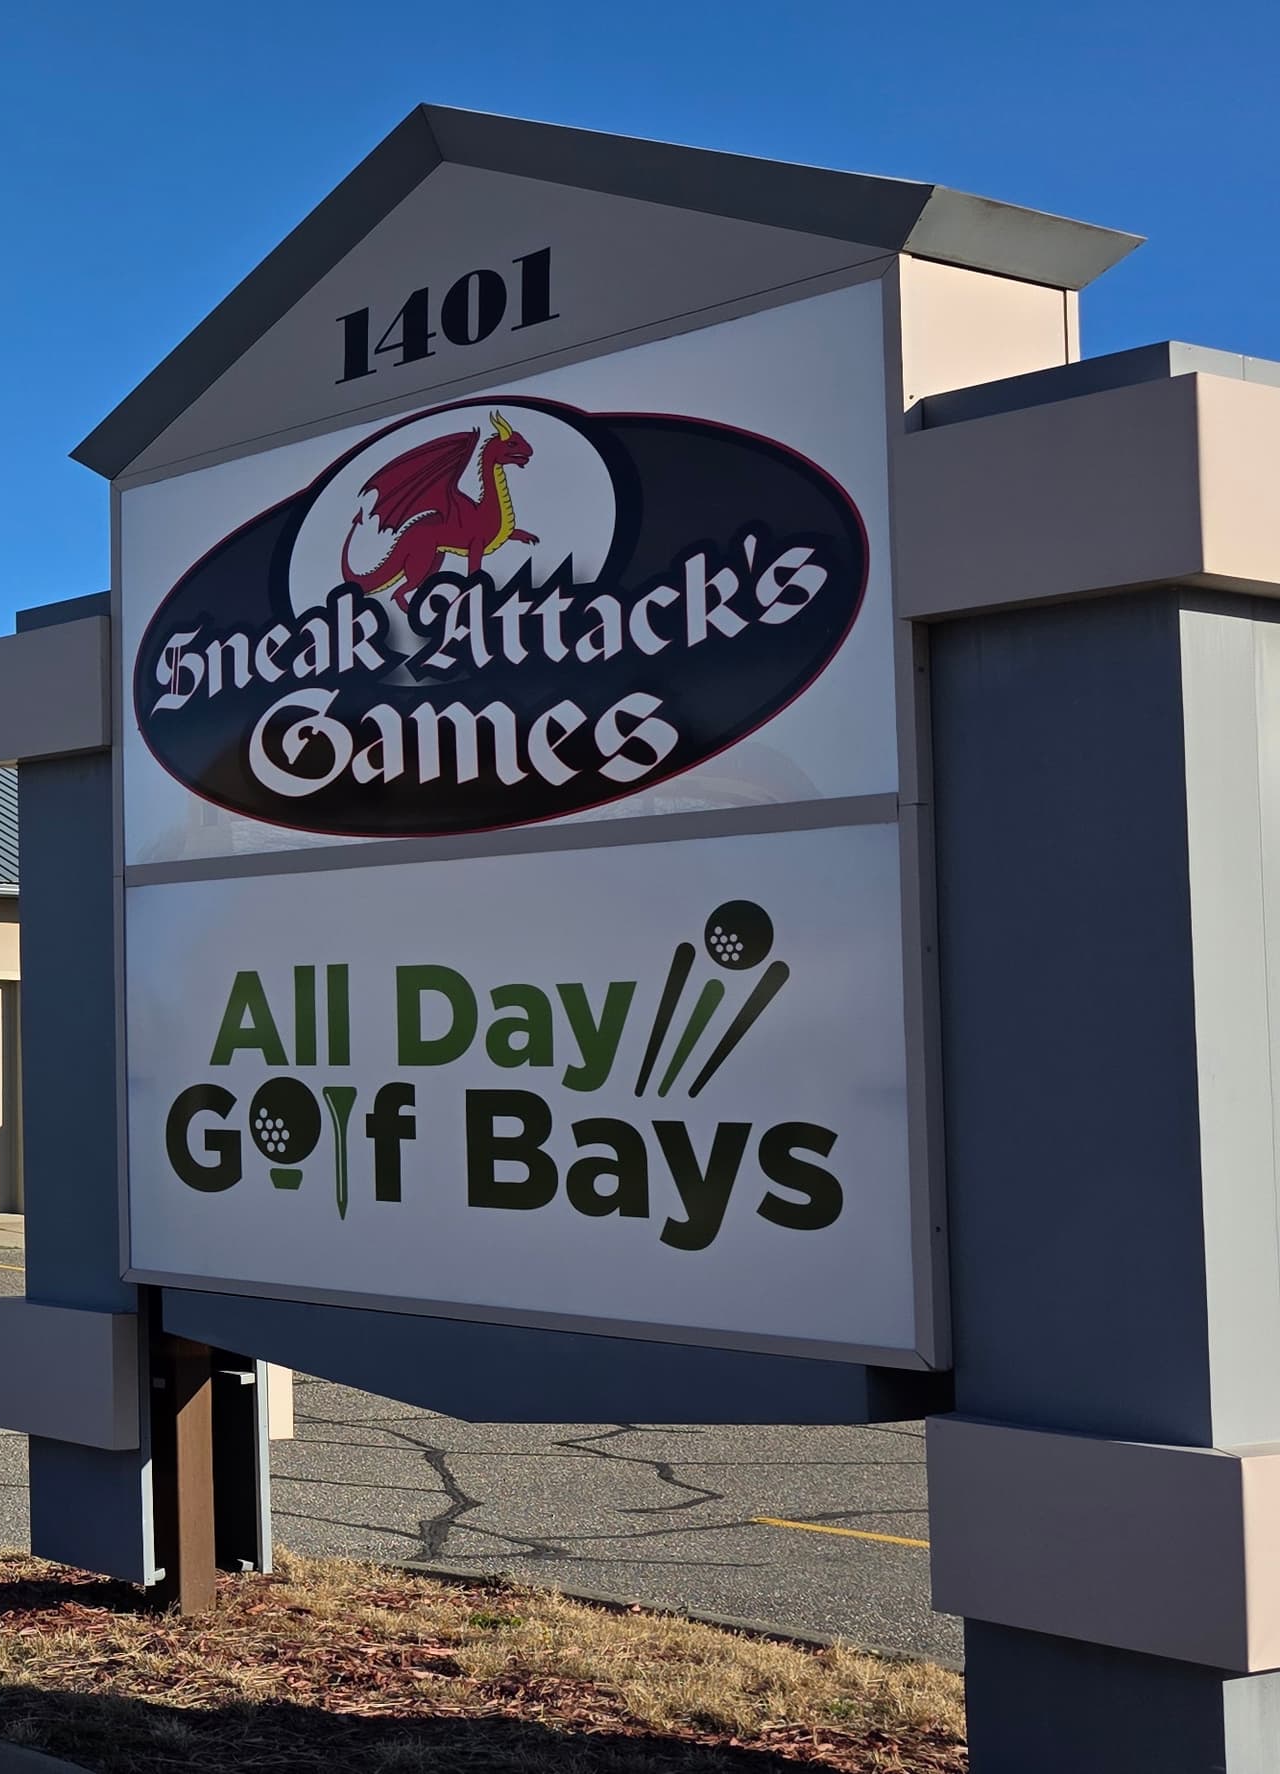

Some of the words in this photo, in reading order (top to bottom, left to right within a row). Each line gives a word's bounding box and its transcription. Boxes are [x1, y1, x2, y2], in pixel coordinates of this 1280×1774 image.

[335, 247, 561, 384] 1401
[152, 590, 386, 713] Sneak
[417, 533, 829, 675] Attack's
[248, 689, 680, 798] Games
[209, 964, 351, 1067] All
[396, 964, 638, 1092] Day
[165, 1076, 417, 1221] Golf
[465, 1088, 845, 1252] Bays
